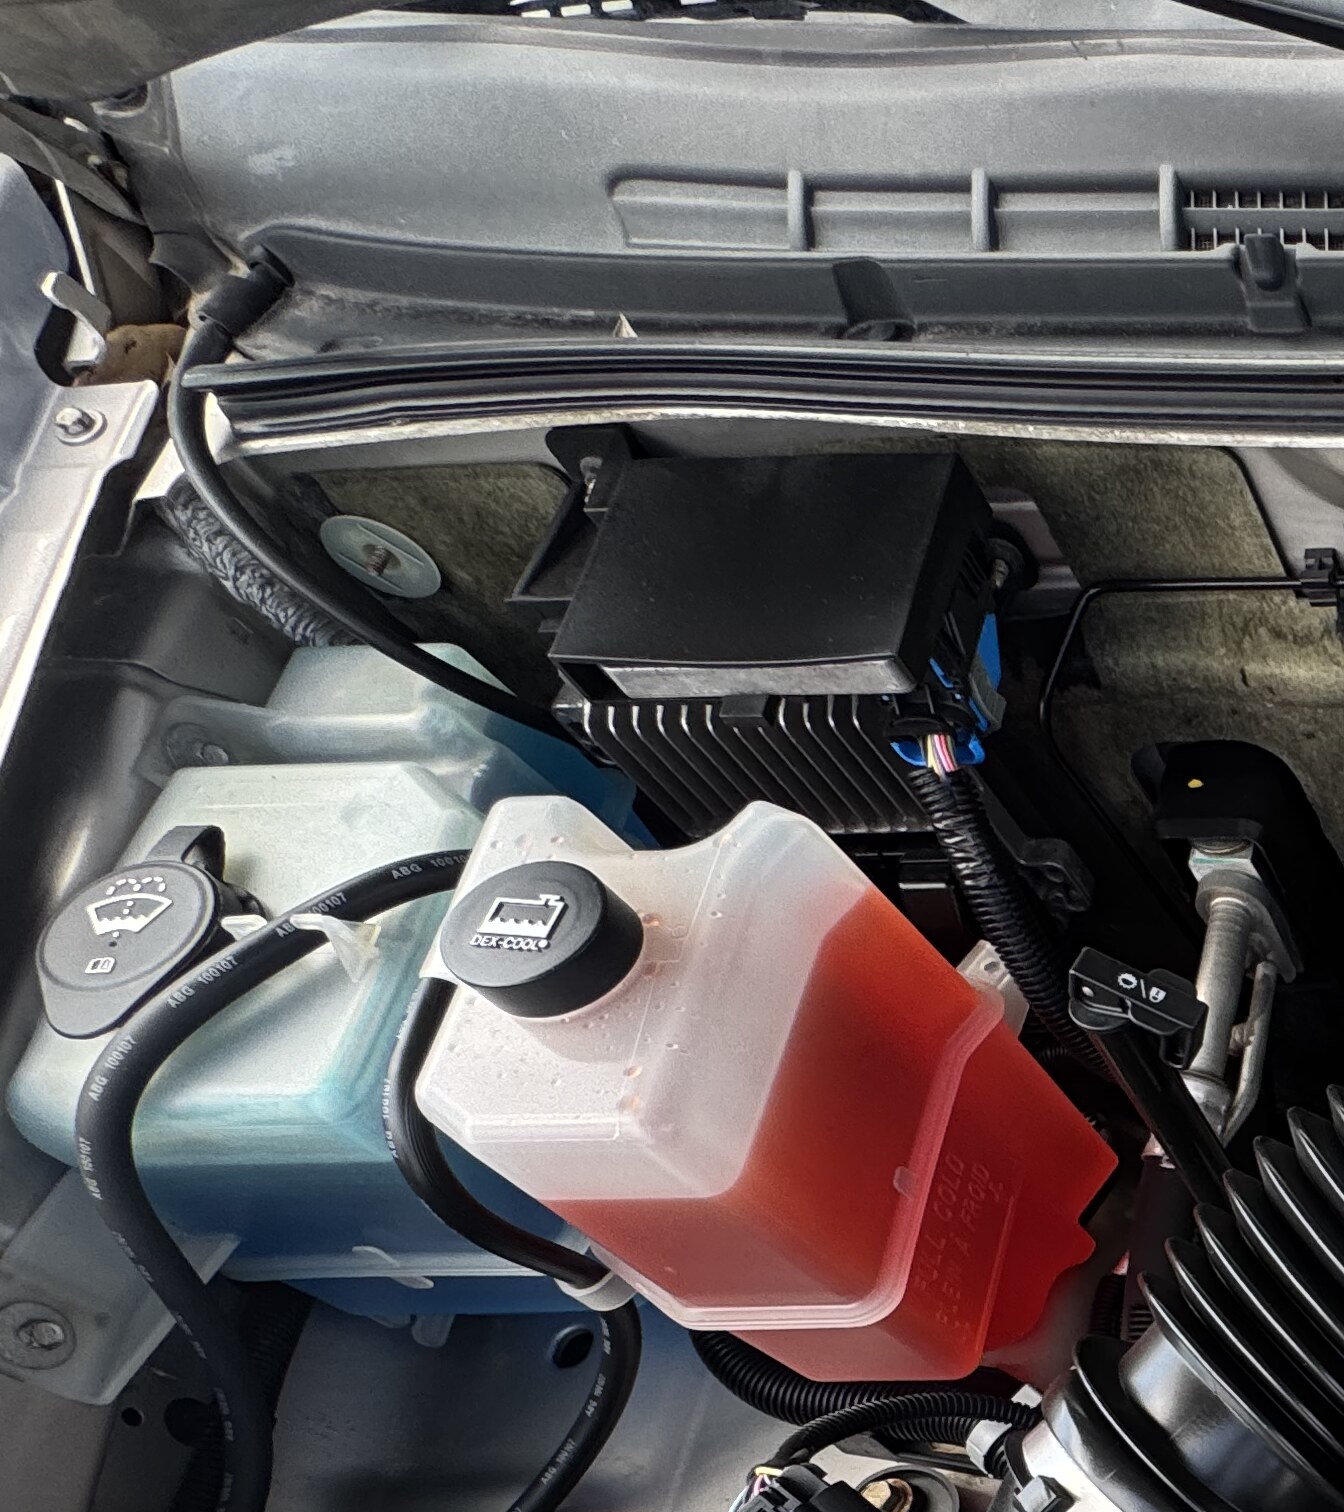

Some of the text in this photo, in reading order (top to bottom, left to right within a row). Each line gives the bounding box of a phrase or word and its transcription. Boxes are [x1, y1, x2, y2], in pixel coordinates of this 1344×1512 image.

[430, 854, 467, 869] 10010
[167, 955, 240, 1009] ABG 100107
[89, 1035, 137, 1102] ABG 100107
